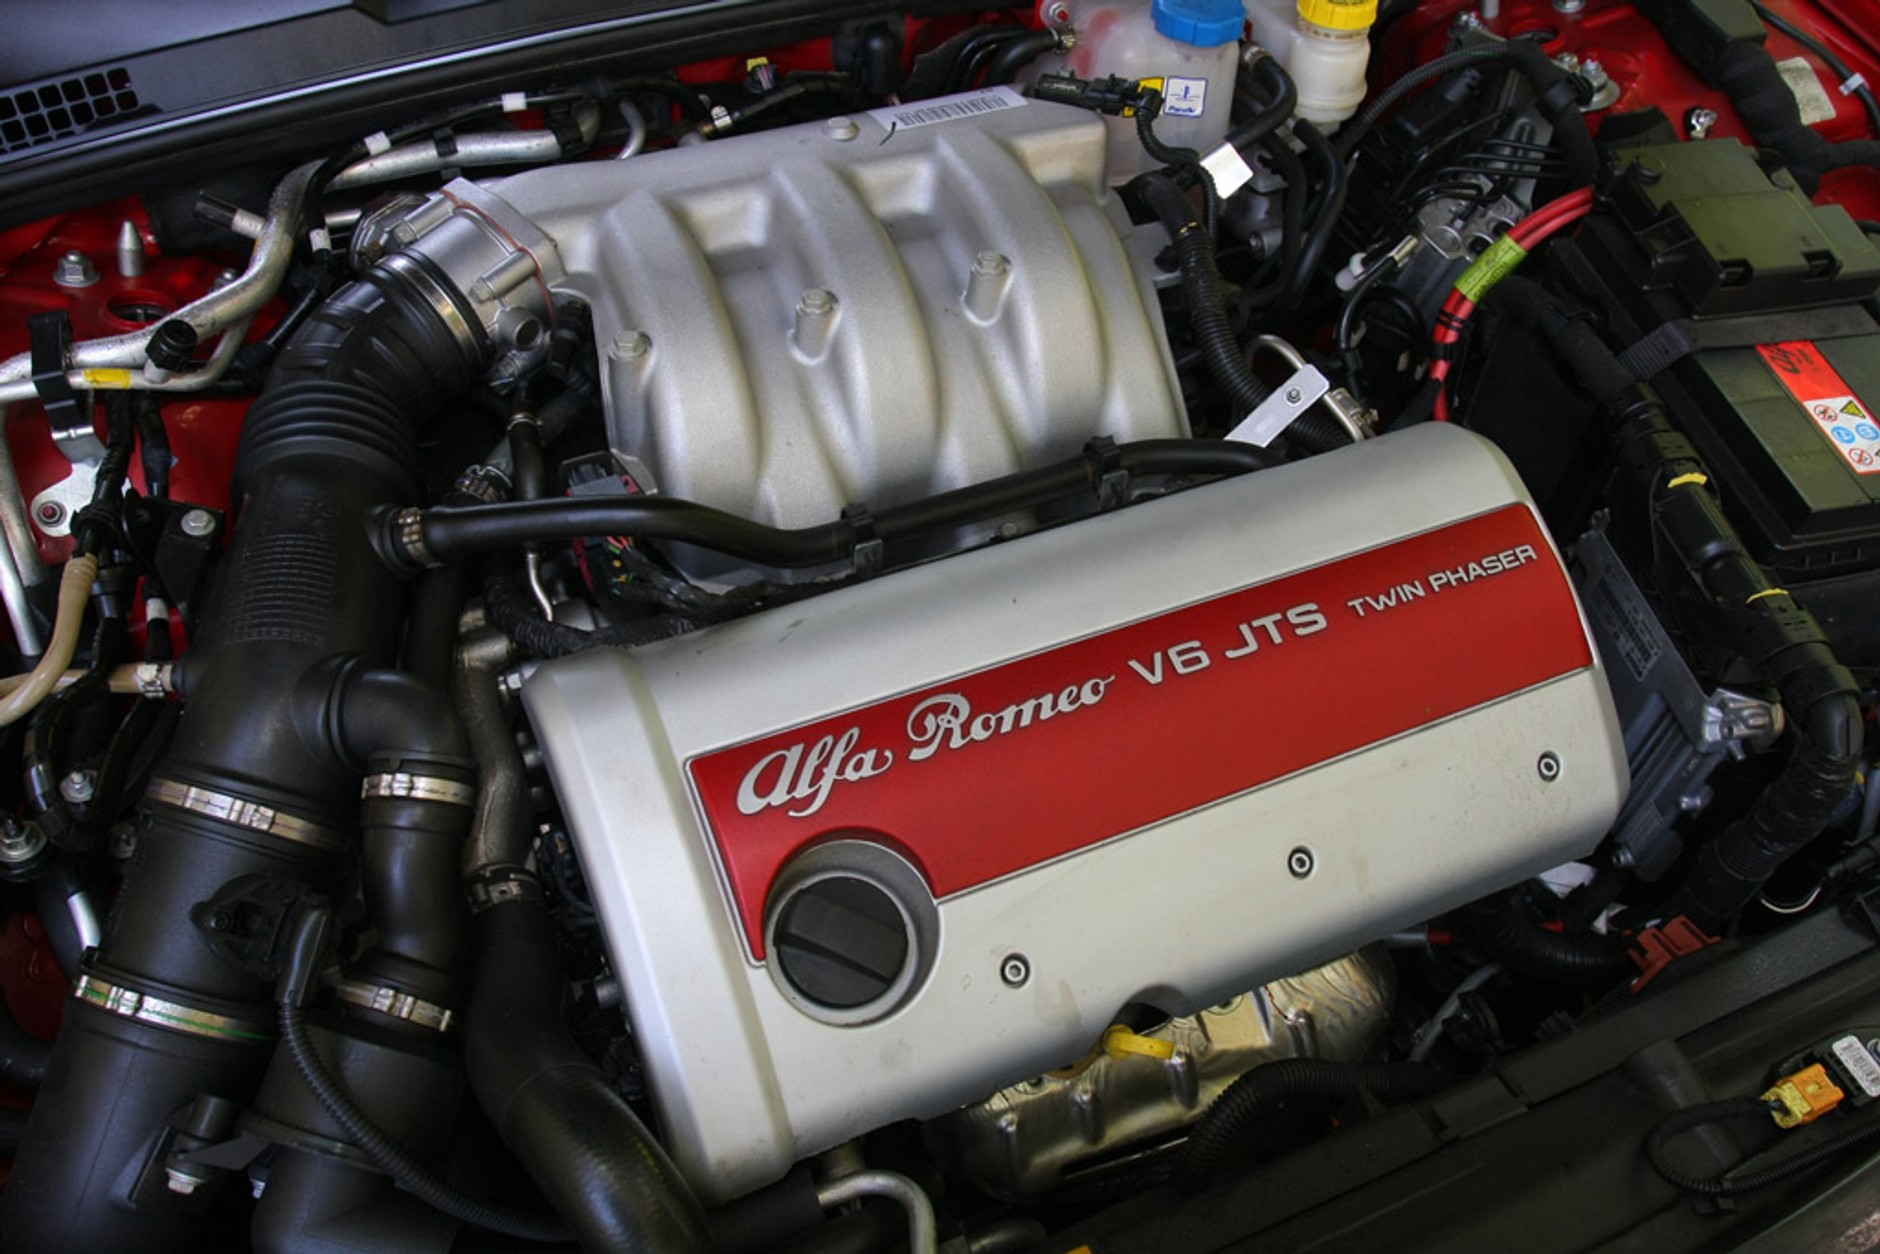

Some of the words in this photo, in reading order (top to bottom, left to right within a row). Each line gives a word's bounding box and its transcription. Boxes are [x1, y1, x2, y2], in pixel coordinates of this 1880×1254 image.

[736, 726, 894, 818] Alfa
[906, 674, 1116, 762] Romeo
[1127, 640, 1211, 685] V6
[1225, 603, 1327, 659] JTS
[1347, 579, 1426, 617] TWIN
[1428, 544, 1538, 592] PHASER
